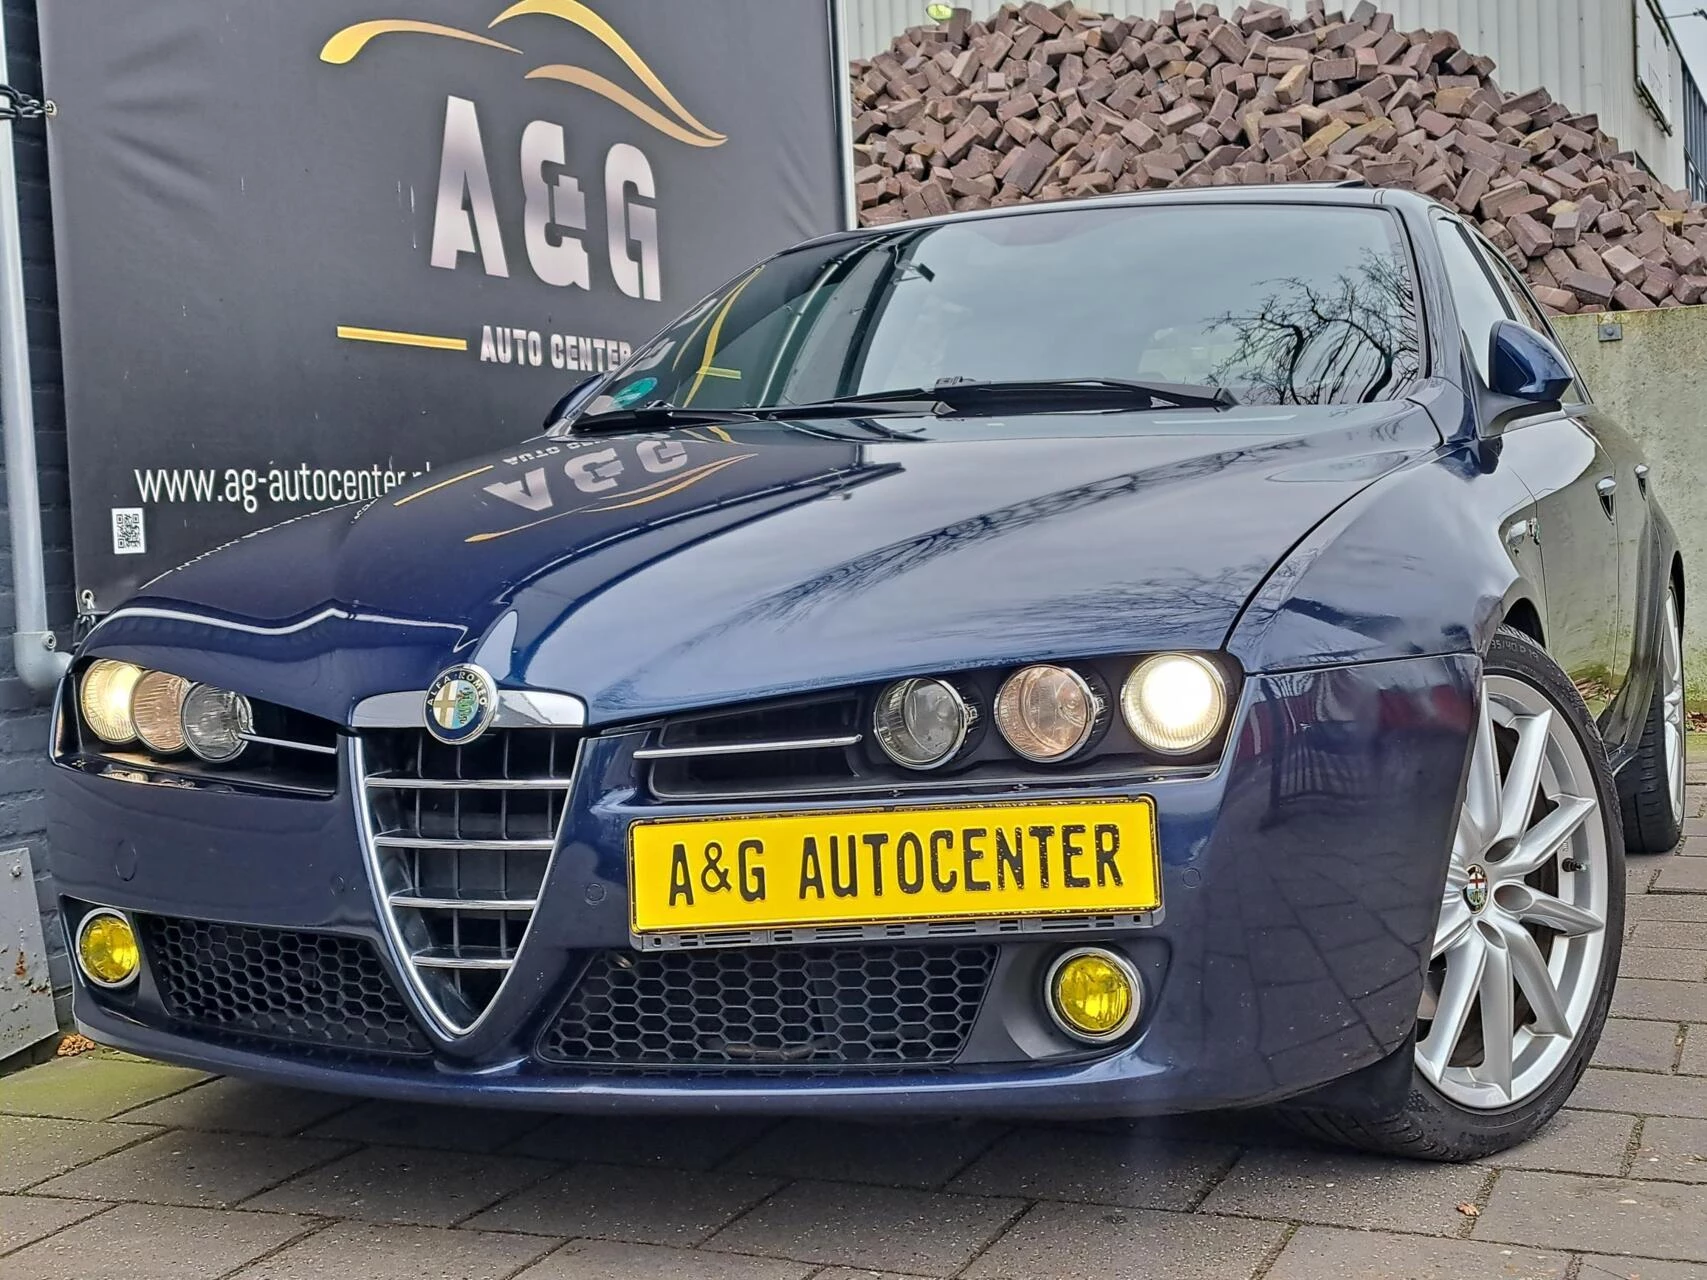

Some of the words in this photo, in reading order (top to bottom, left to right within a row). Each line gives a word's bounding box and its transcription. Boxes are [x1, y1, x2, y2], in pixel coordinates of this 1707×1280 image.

[430, 95, 662, 302] A&G
[480, 325, 543, 367] AUTO
[134, 462, 431, 513] www.ag-autocenter
[427, 675, 452, 706] ALFA
[458, 671, 487, 706] ROMEO
[668, 838, 767, 907] A&G
[799, 823, 1125, 900] AUTOCENTER
